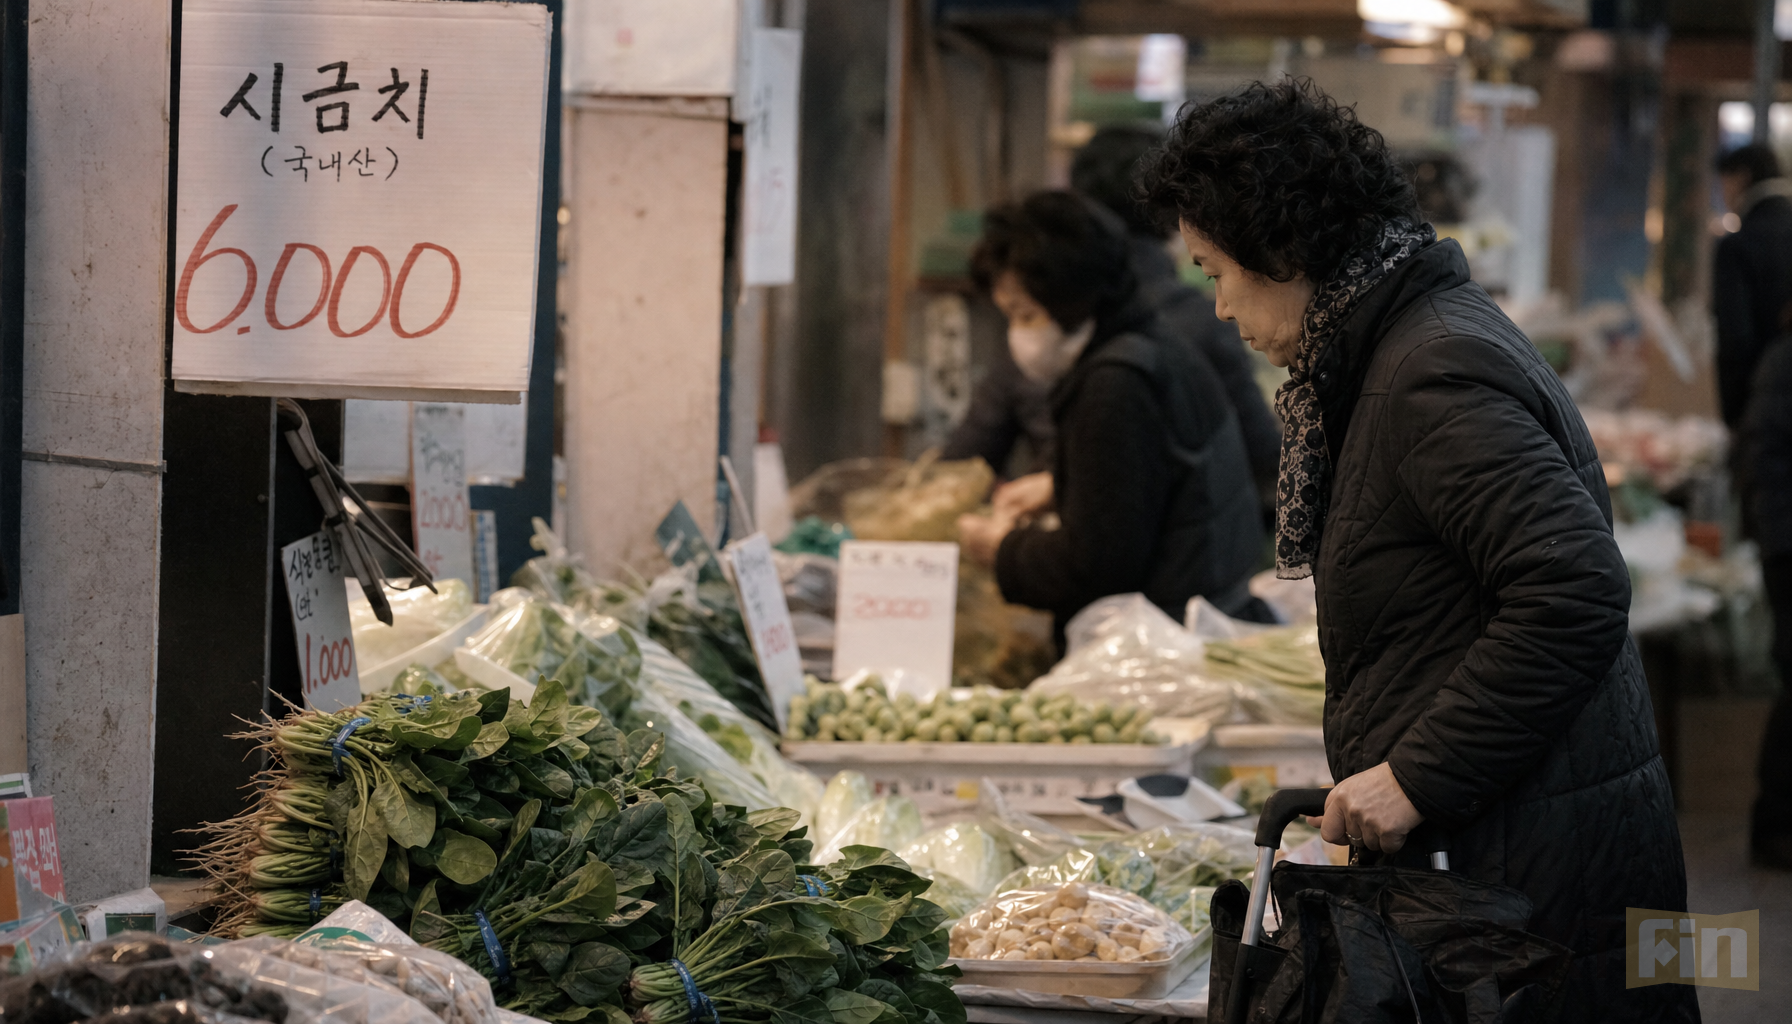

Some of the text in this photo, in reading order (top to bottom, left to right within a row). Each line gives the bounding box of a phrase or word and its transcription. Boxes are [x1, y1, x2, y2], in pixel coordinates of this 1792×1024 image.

[219, 61, 429, 140] 시금치
[260, 145, 399, 182] (국내산)
[176, 203, 462, 339] 6.000
[305, 632, 353, 694] 1.000
